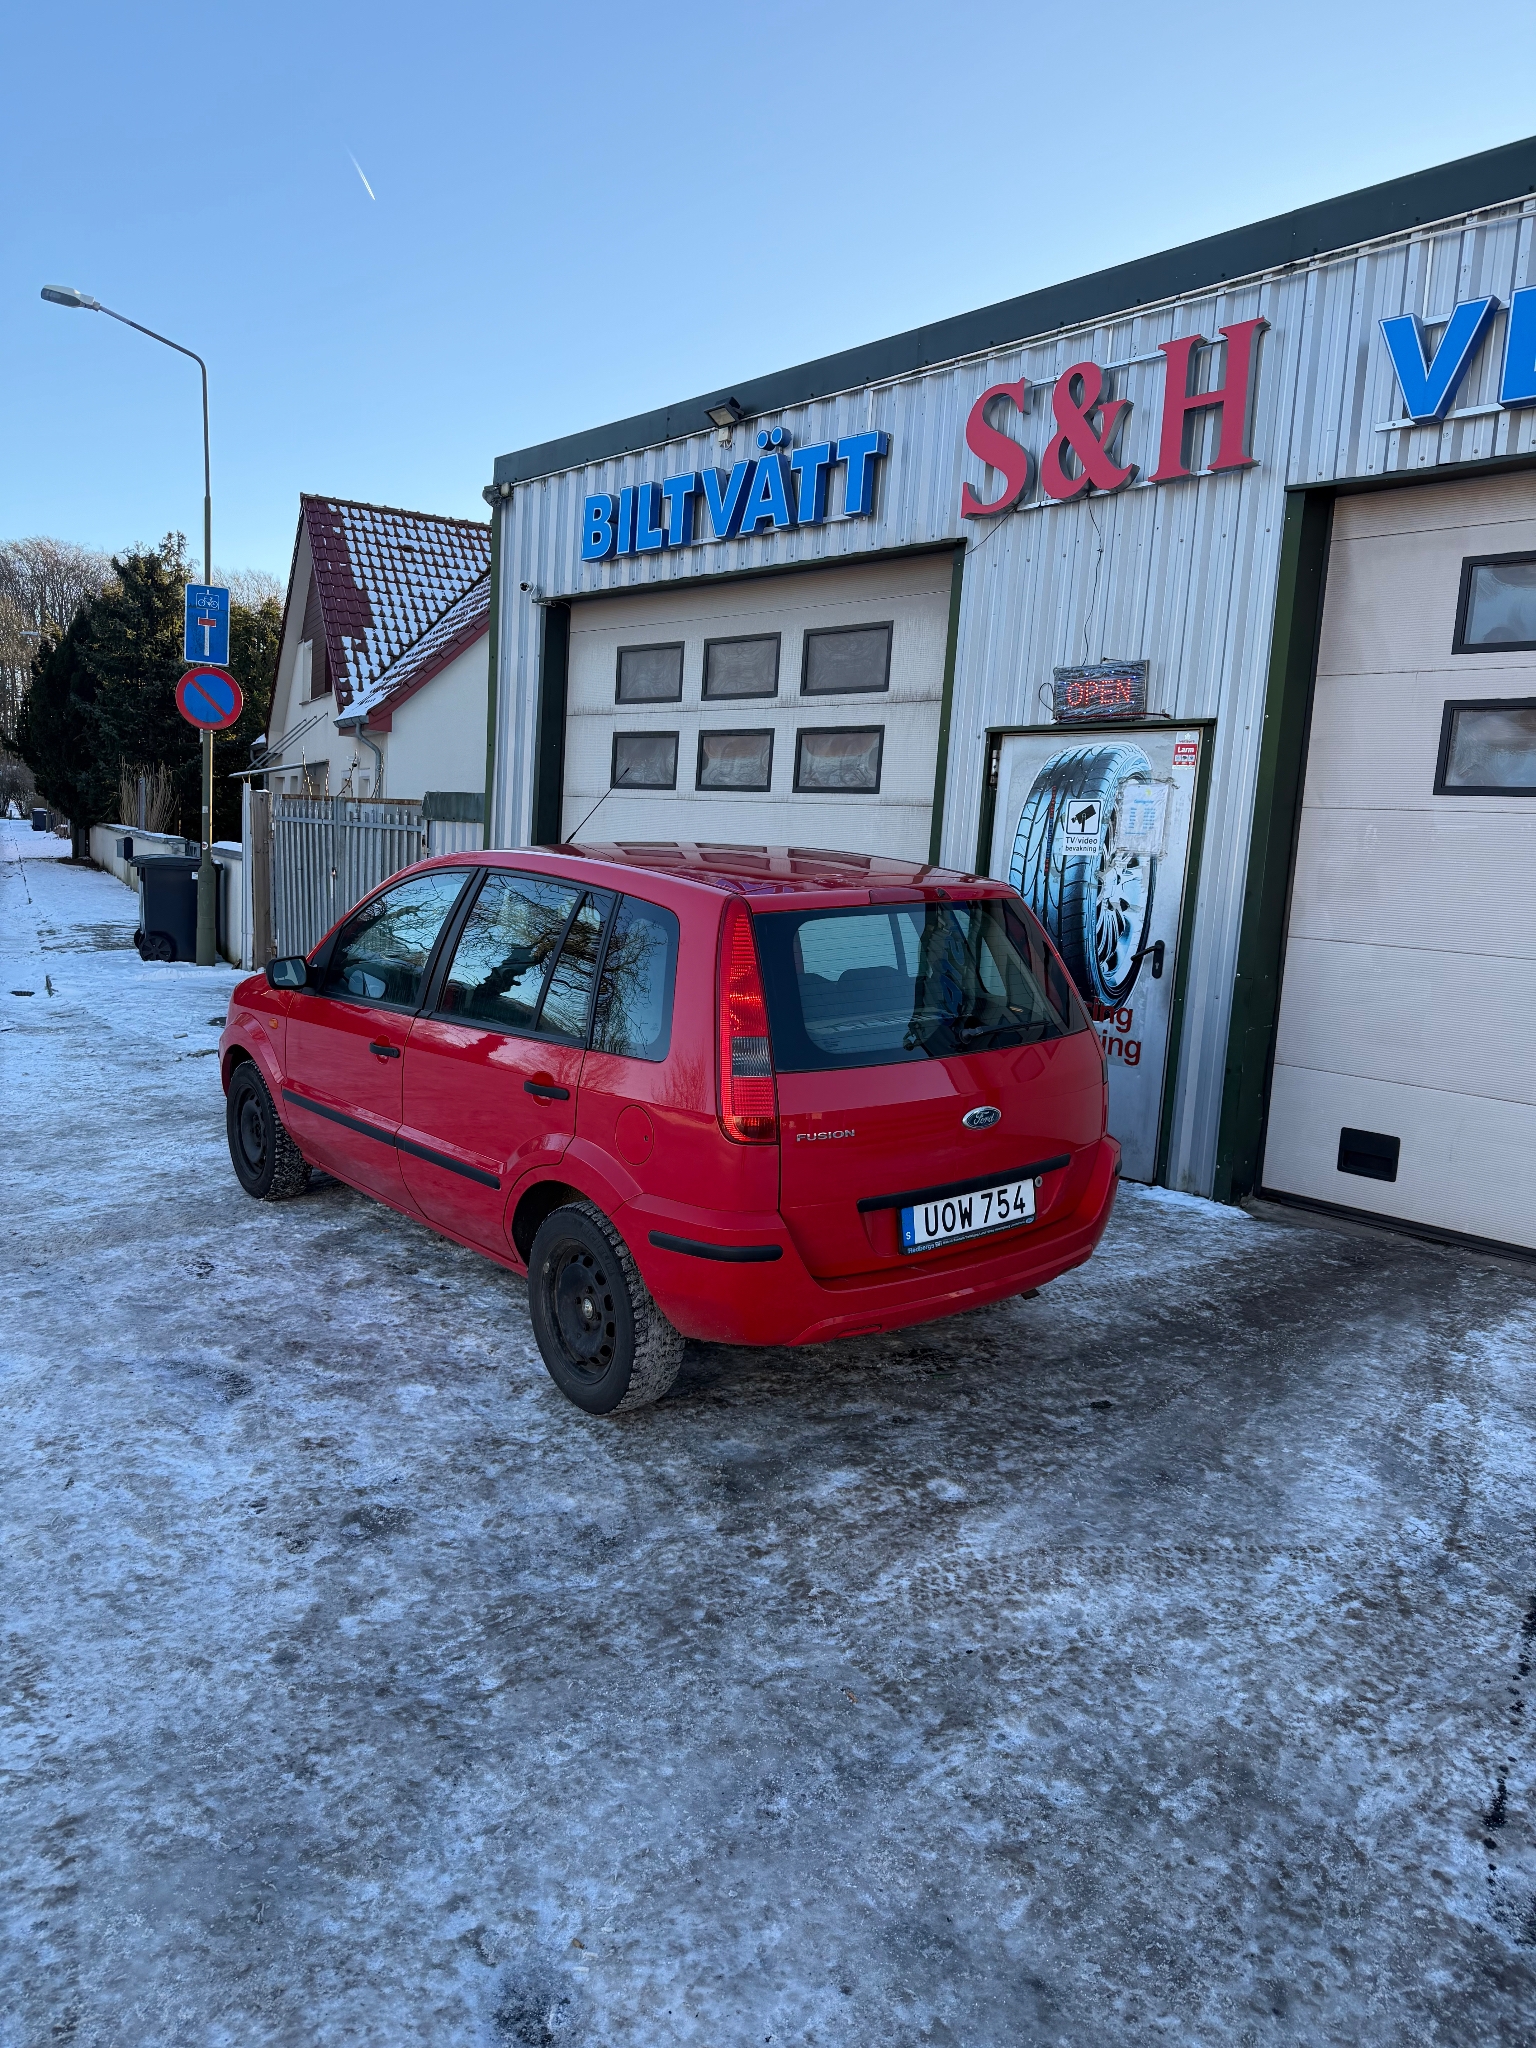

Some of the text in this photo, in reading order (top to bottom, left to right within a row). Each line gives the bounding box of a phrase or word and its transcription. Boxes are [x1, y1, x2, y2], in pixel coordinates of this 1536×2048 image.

[961, 316, 1271, 520] S&H
[581, 426, 889, 563] BILTVÄTT
[1067, 678, 1131, 706] OPEN
[1177, 746, 1195, 754] Larm
[1065, 836, 1098, 845] TV/video
[1065, 845, 1097, 853] bevakning
[1101, 1029, 1141, 1066] ing
[796, 1129, 855, 1142] FUSION
[924, 1196, 973, 1237] UOW
[980, 1184, 1025, 1223] 754
[905, 1231, 911, 1240] S
